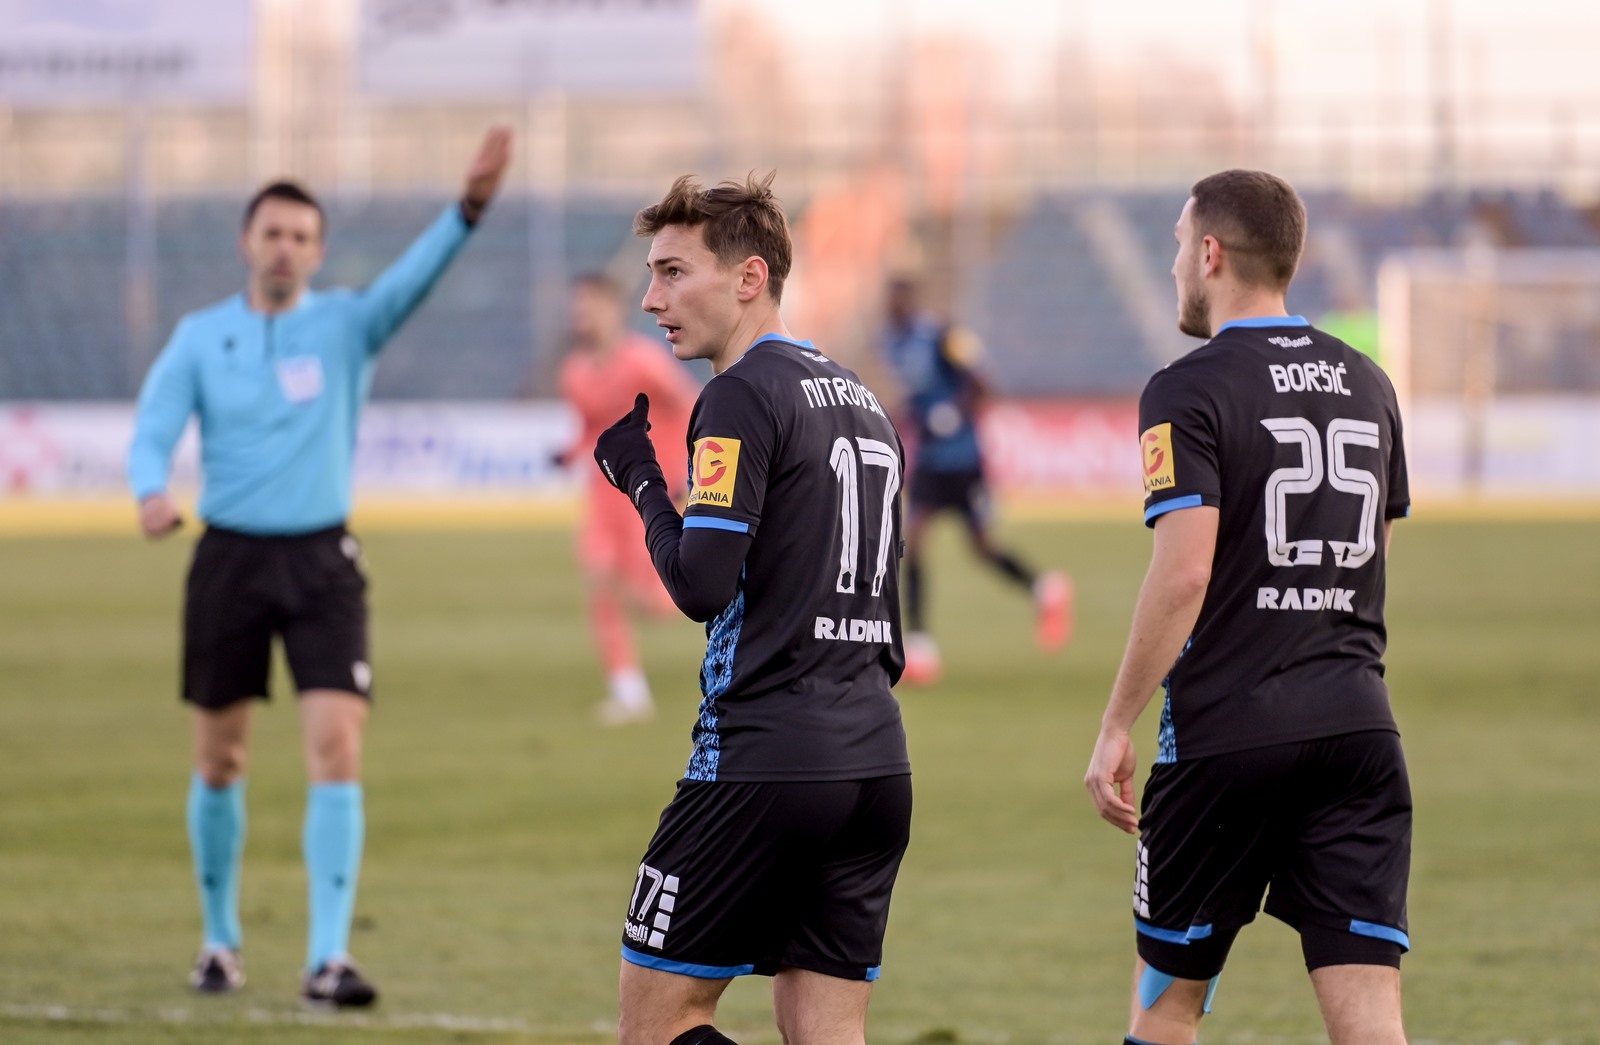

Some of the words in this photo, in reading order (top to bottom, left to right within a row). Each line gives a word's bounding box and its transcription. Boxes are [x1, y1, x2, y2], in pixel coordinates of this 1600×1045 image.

[1268, 360, 1352, 396] BORŠIĆ
[830, 437, 899, 597] 17
[1260, 417, 1379, 569] 25
[629, 862, 664, 922] 17
